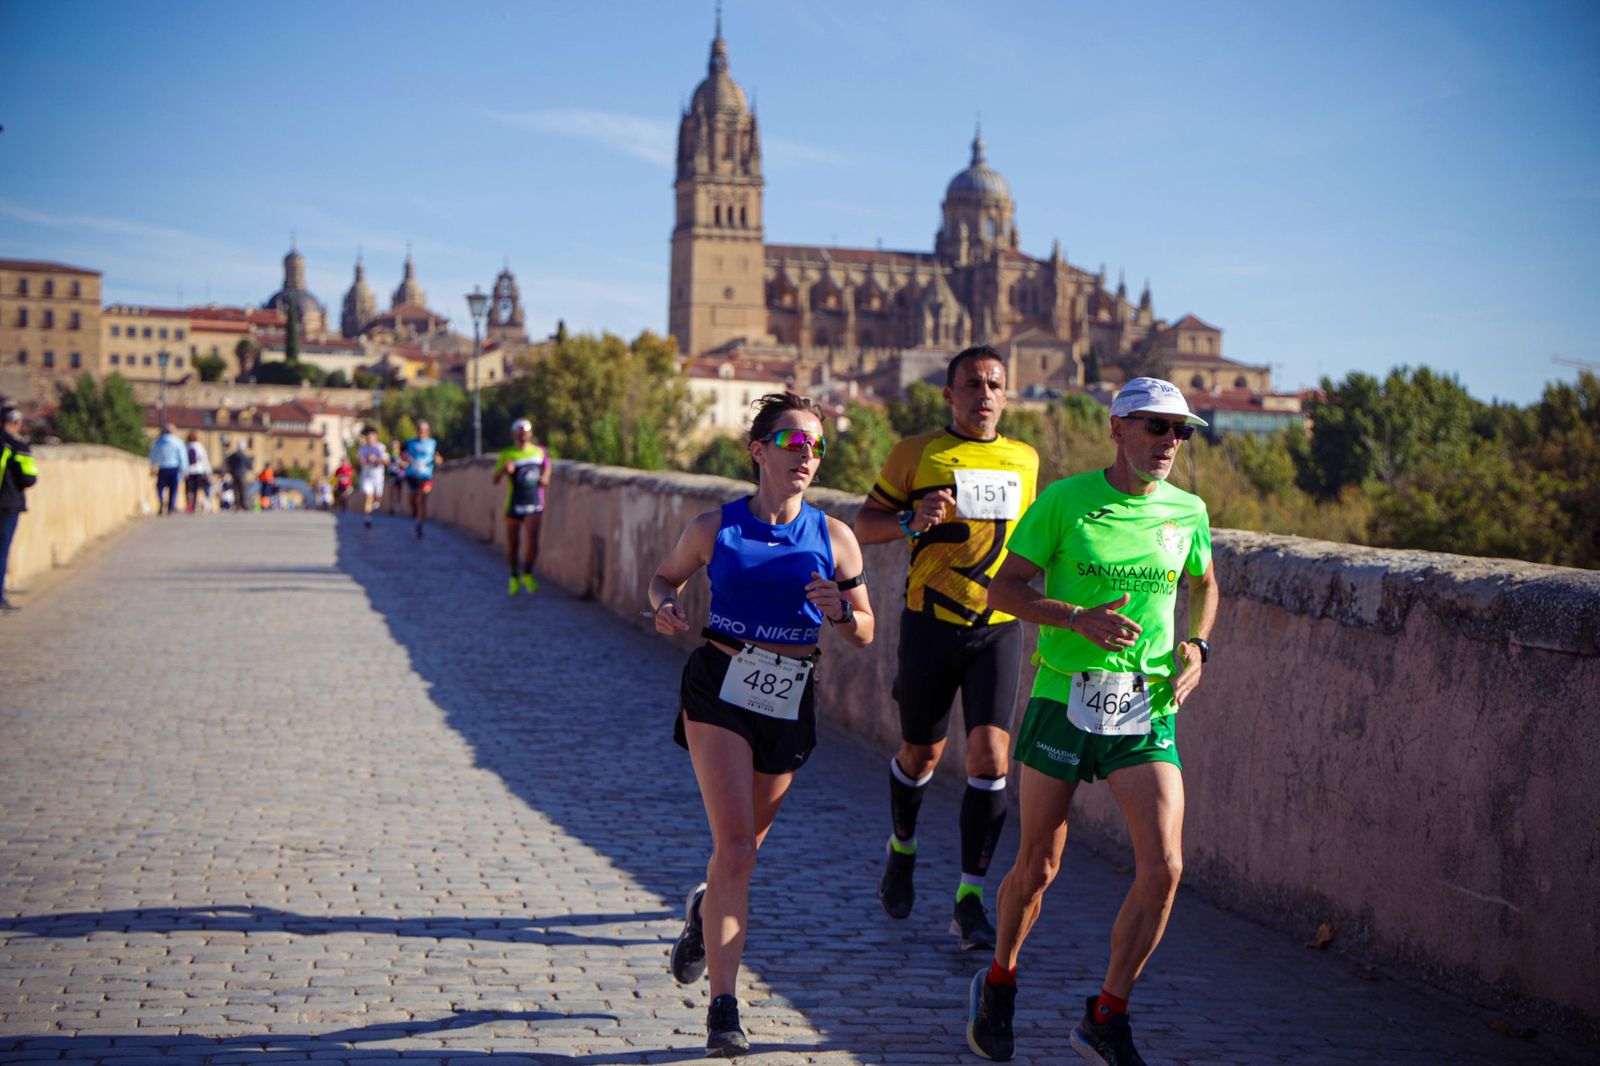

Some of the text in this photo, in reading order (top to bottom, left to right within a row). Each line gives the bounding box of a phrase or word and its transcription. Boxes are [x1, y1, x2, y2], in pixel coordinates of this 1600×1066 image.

[972, 484, 1007, 502] 151
[1077, 562, 1176, 583] SANMAXIMO
[1111, 578, 1170, 595] TELECOM
[710, 614, 746, 634] PRO
[755, 625, 802, 641] NIKE
[743, 669, 793, 700] 482
[1086, 690, 1131, 715] 466
[1035, 741, 1078, 759] SANMAXIMO
